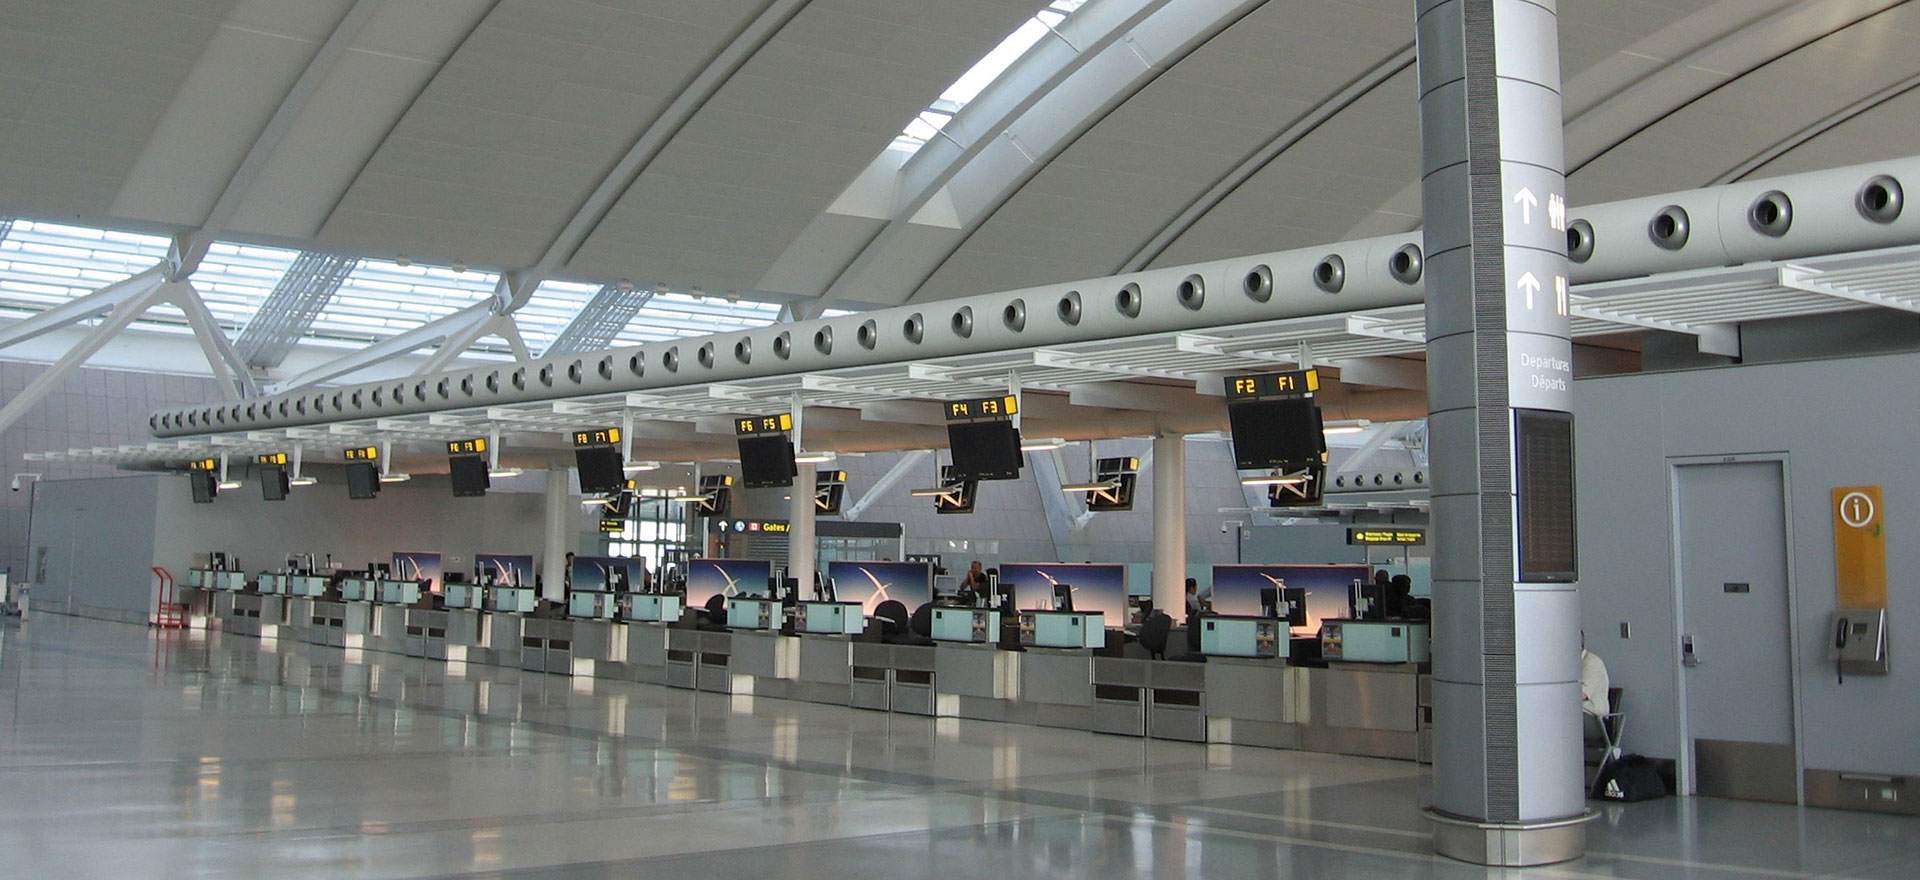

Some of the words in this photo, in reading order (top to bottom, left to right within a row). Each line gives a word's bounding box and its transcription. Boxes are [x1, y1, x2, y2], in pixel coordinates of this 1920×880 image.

[1520, 353, 1570, 372] Departures
[1235, 379, 1255, 394] F2
[1278, 376, 1294, 391] F1
[1531, 374, 1566, 391] Départs
[952, 403, 969, 417] F4
[982, 400, 998, 414] F3
[741, 420, 753, 432] F6
[763, 418, 776, 430] F5
[595, 431, 606, 442] F7
[763, 522, 785, 532] Gates
